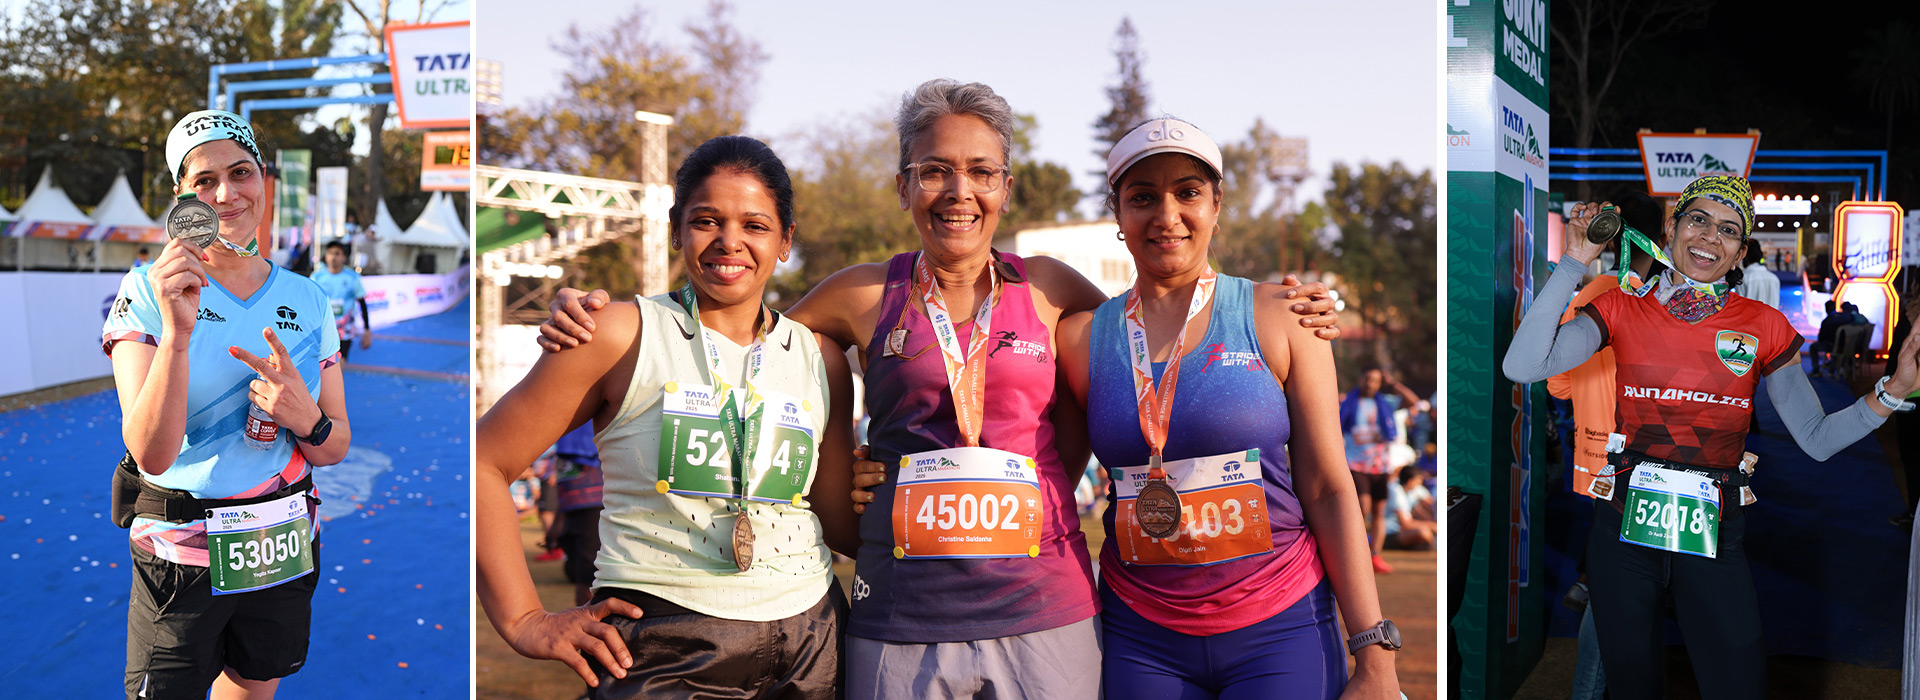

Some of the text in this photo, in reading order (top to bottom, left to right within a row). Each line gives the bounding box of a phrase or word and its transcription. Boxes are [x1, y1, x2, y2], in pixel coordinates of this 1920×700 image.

[1504, 24, 1544, 86] MEDAL
[416, 79, 470, 95] ULTR
[183, 115, 238, 128] TATA
[1503, 105, 1524, 136] TATA
[1147, 120, 1184, 142] alo
[1504, 134, 1525, 161] ULTRA
[1656, 153, 1694, 163] TATA
[1658, 168, 1697, 177] ULTRA
[276, 321, 302, 332] TATA
[1012, 340, 1046, 352] STRIDE
[1014, 346, 1040, 357] WITH
[1222, 358, 1250, 366] WITH
[684, 391, 709, 399] TATA
[686, 398, 710, 407] ULTRA
[1160, 383, 1170, 414] CHALLENGE
[1624, 385, 1750, 409] RUNAHOLICS
[781, 414, 800, 424] TATA
[962, 403, 972, 435] CHALLENGE
[728, 420, 737, 437] ULTRA
[1146, 413, 1155, 443] CHALLENGE
[916, 458, 936, 466] TATA
[1221, 472, 1245, 482] TATA
[916, 494, 1020, 530] 45002
[1635, 499, 1704, 534] 52018
[229, 530, 300, 571] 53050
